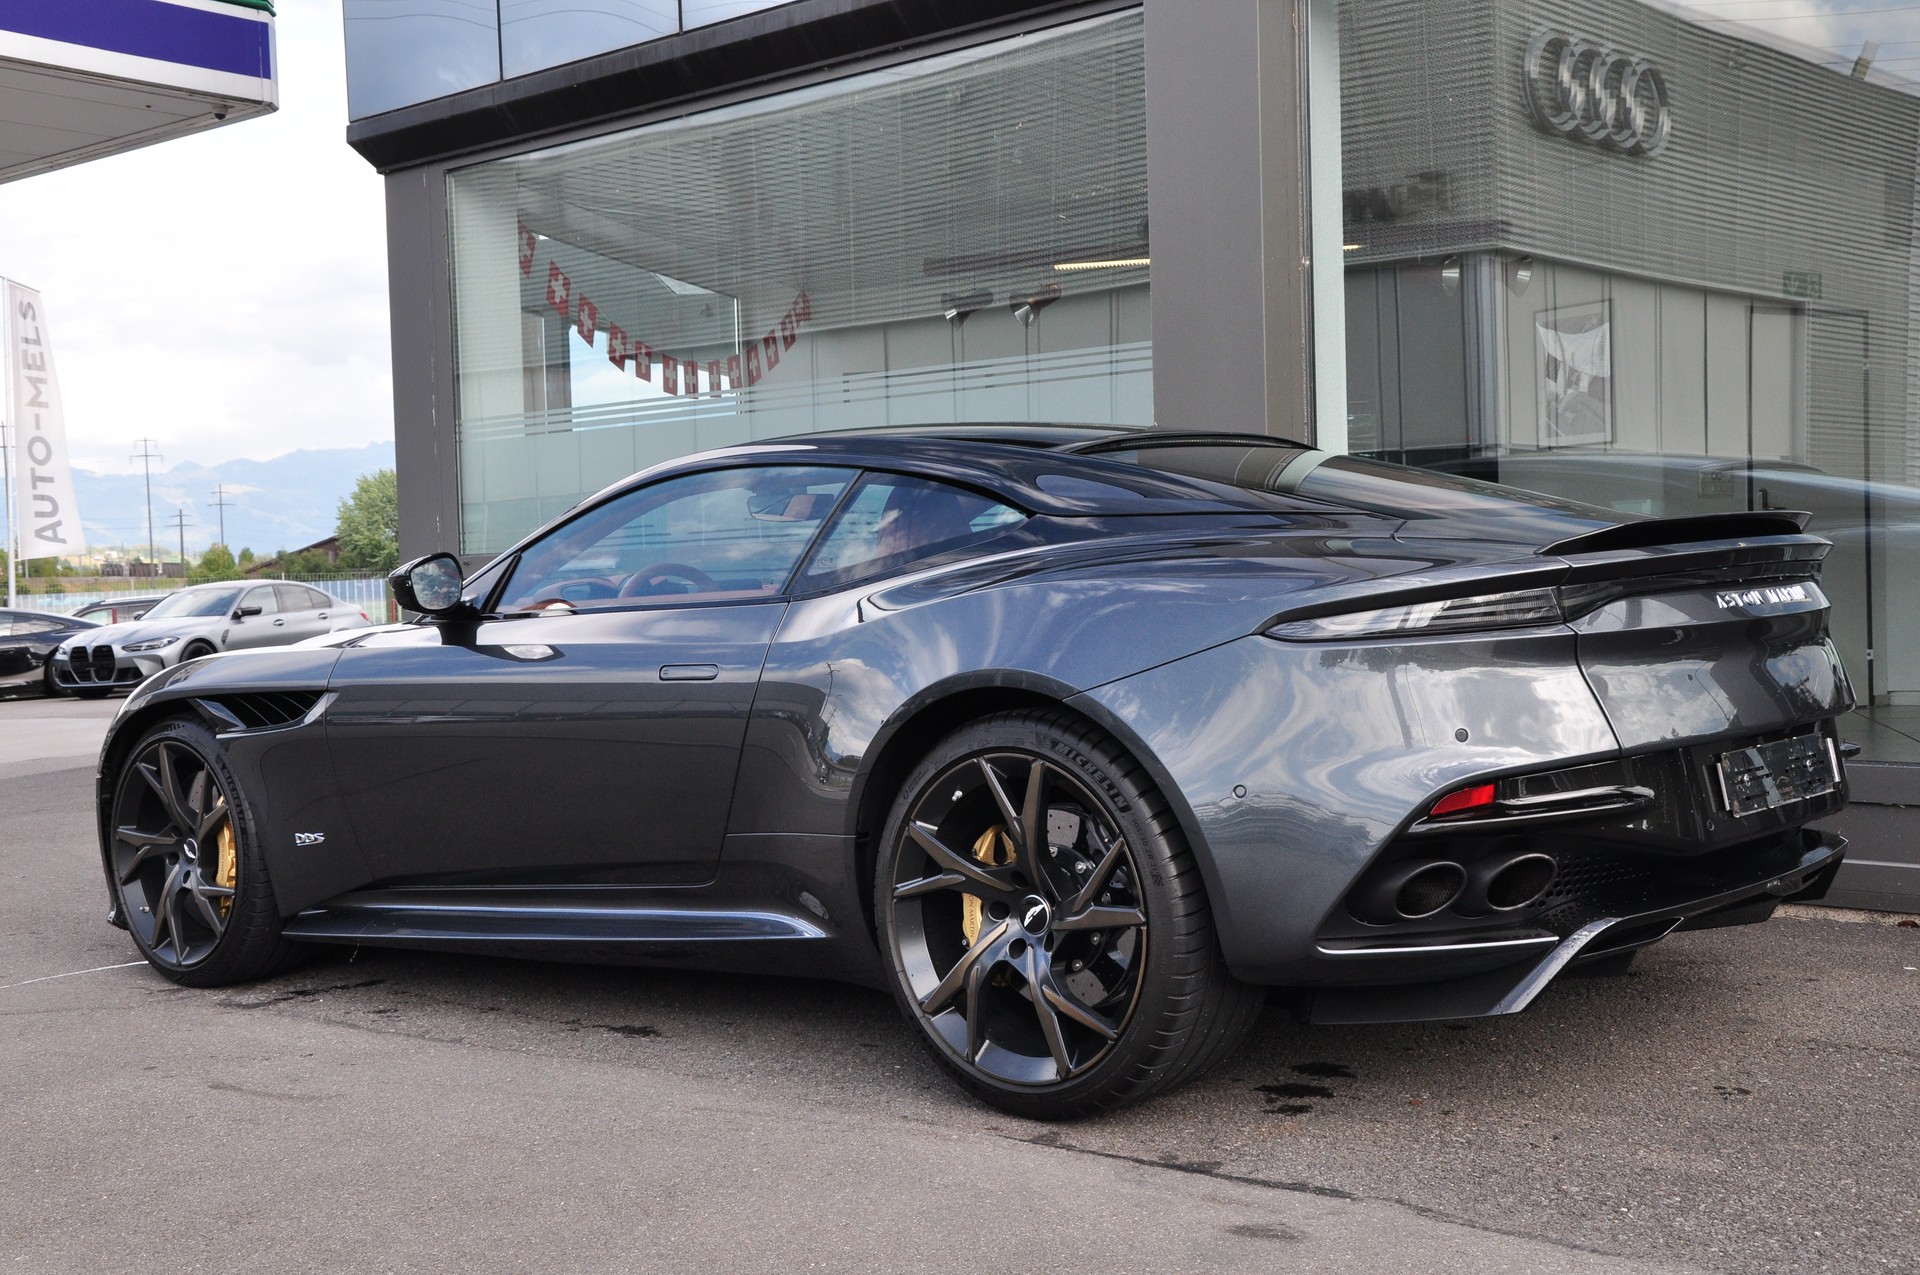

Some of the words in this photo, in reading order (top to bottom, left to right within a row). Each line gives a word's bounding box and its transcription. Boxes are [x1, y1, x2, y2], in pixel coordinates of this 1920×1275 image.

[18, 299, 68, 545] AUTO-MELS
[1716, 591, 1764, 608] ASTON
[1054, 743, 1129, 809] MICHELIN
[294, 832, 325, 846] DBS
